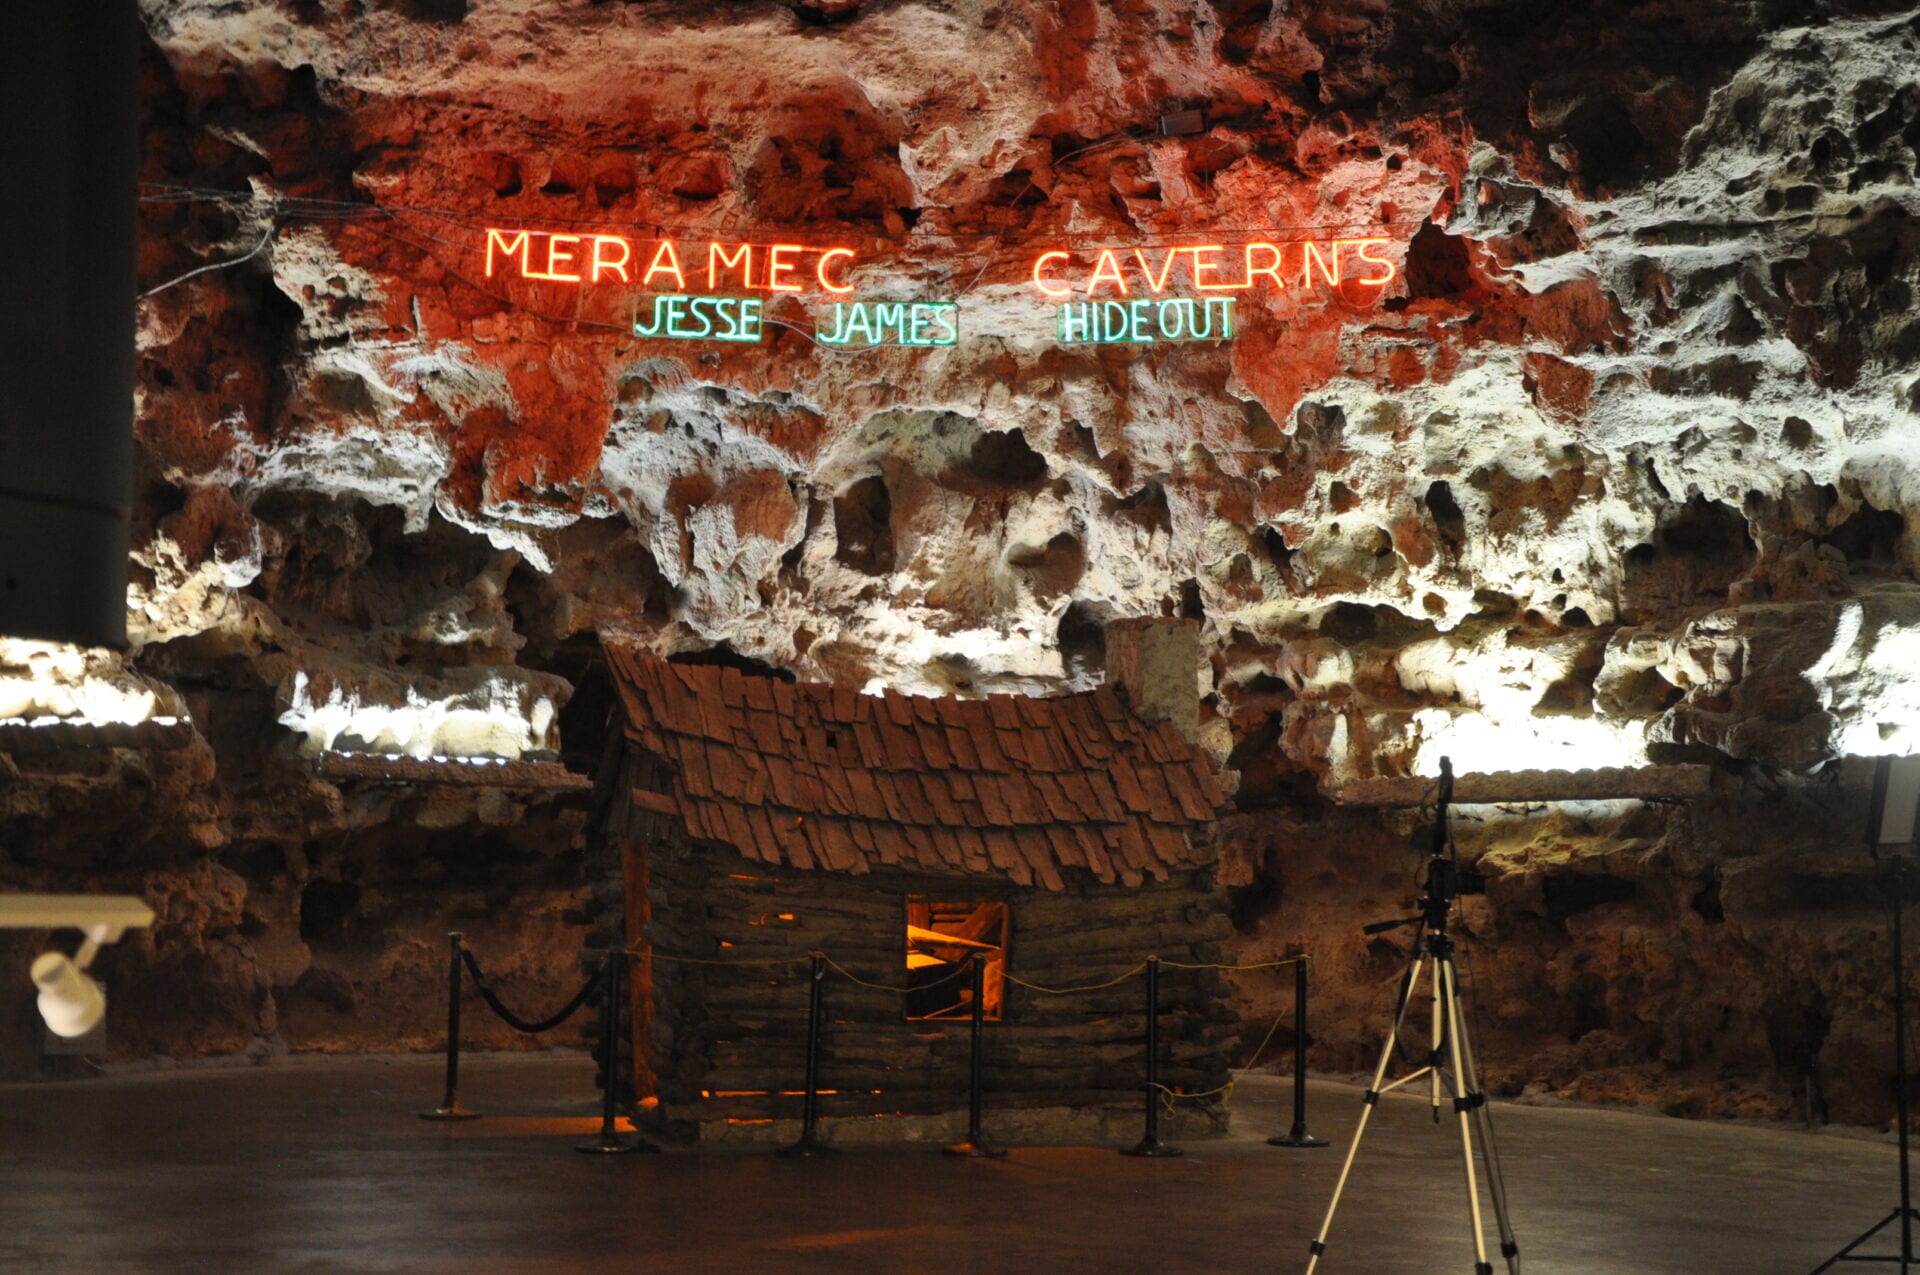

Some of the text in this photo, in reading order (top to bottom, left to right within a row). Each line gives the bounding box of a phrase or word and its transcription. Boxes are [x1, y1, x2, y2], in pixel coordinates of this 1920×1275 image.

[485, 228, 1396, 296] MERAMEC CAVERNS
[635, 297, 762, 340] JESSE
[818, 303, 957, 345] JAMES
